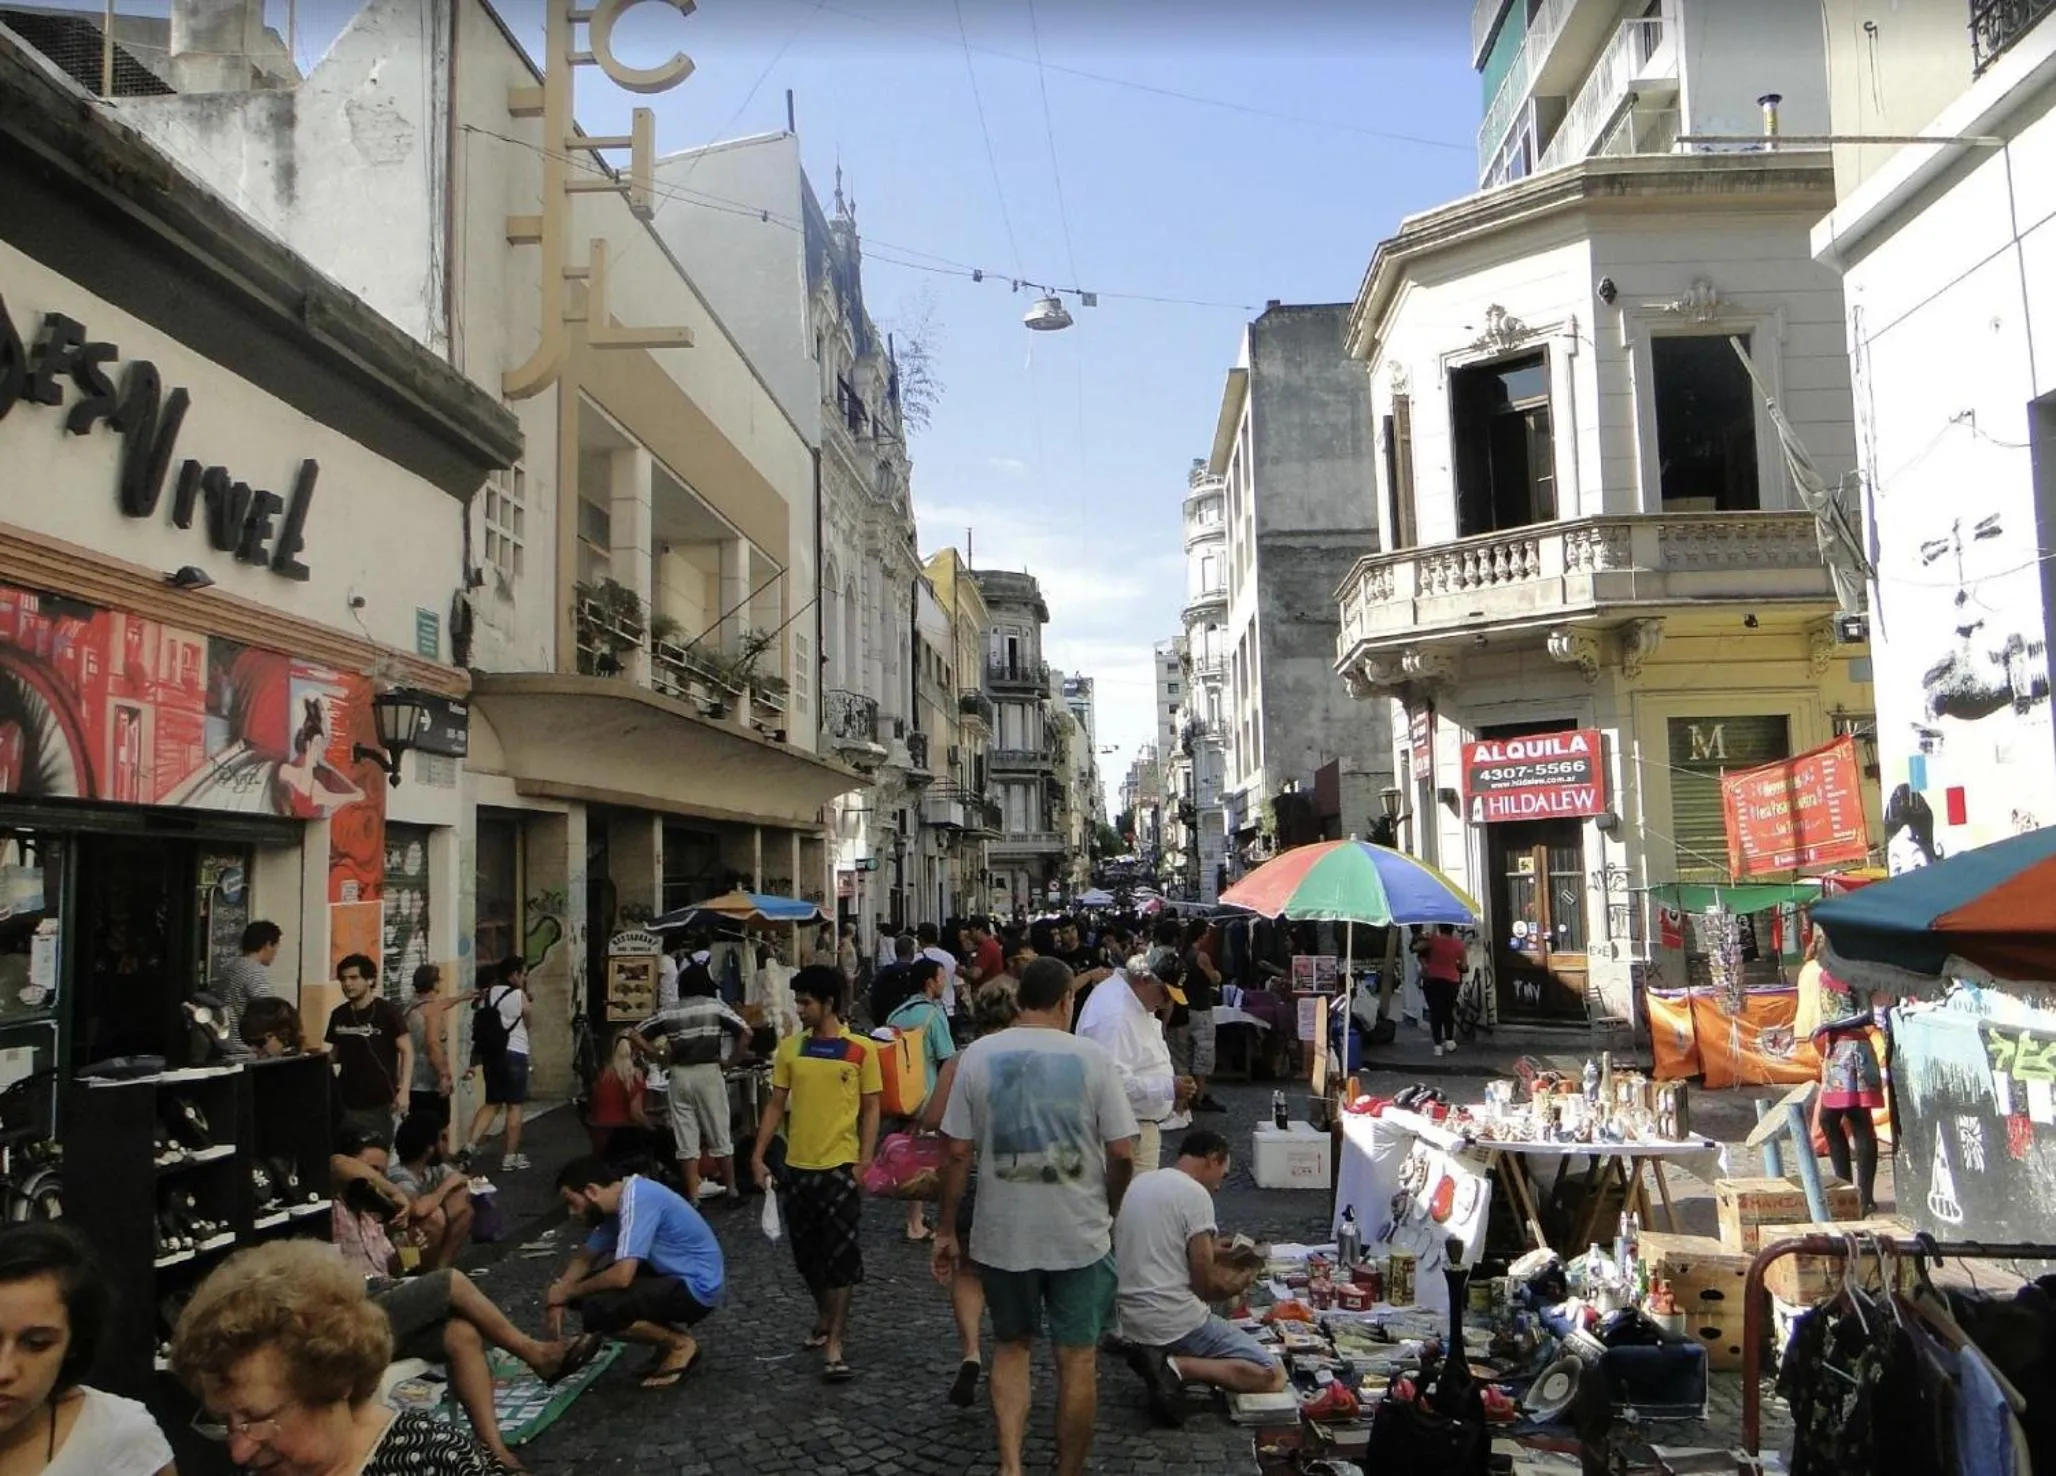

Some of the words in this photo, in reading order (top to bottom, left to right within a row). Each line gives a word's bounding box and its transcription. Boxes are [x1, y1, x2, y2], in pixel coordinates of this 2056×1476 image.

[1473, 735, 1589, 763] ALQUILA
[1687, 723, 1729, 760] M
[1480, 760, 1586, 781] 4307-5566
